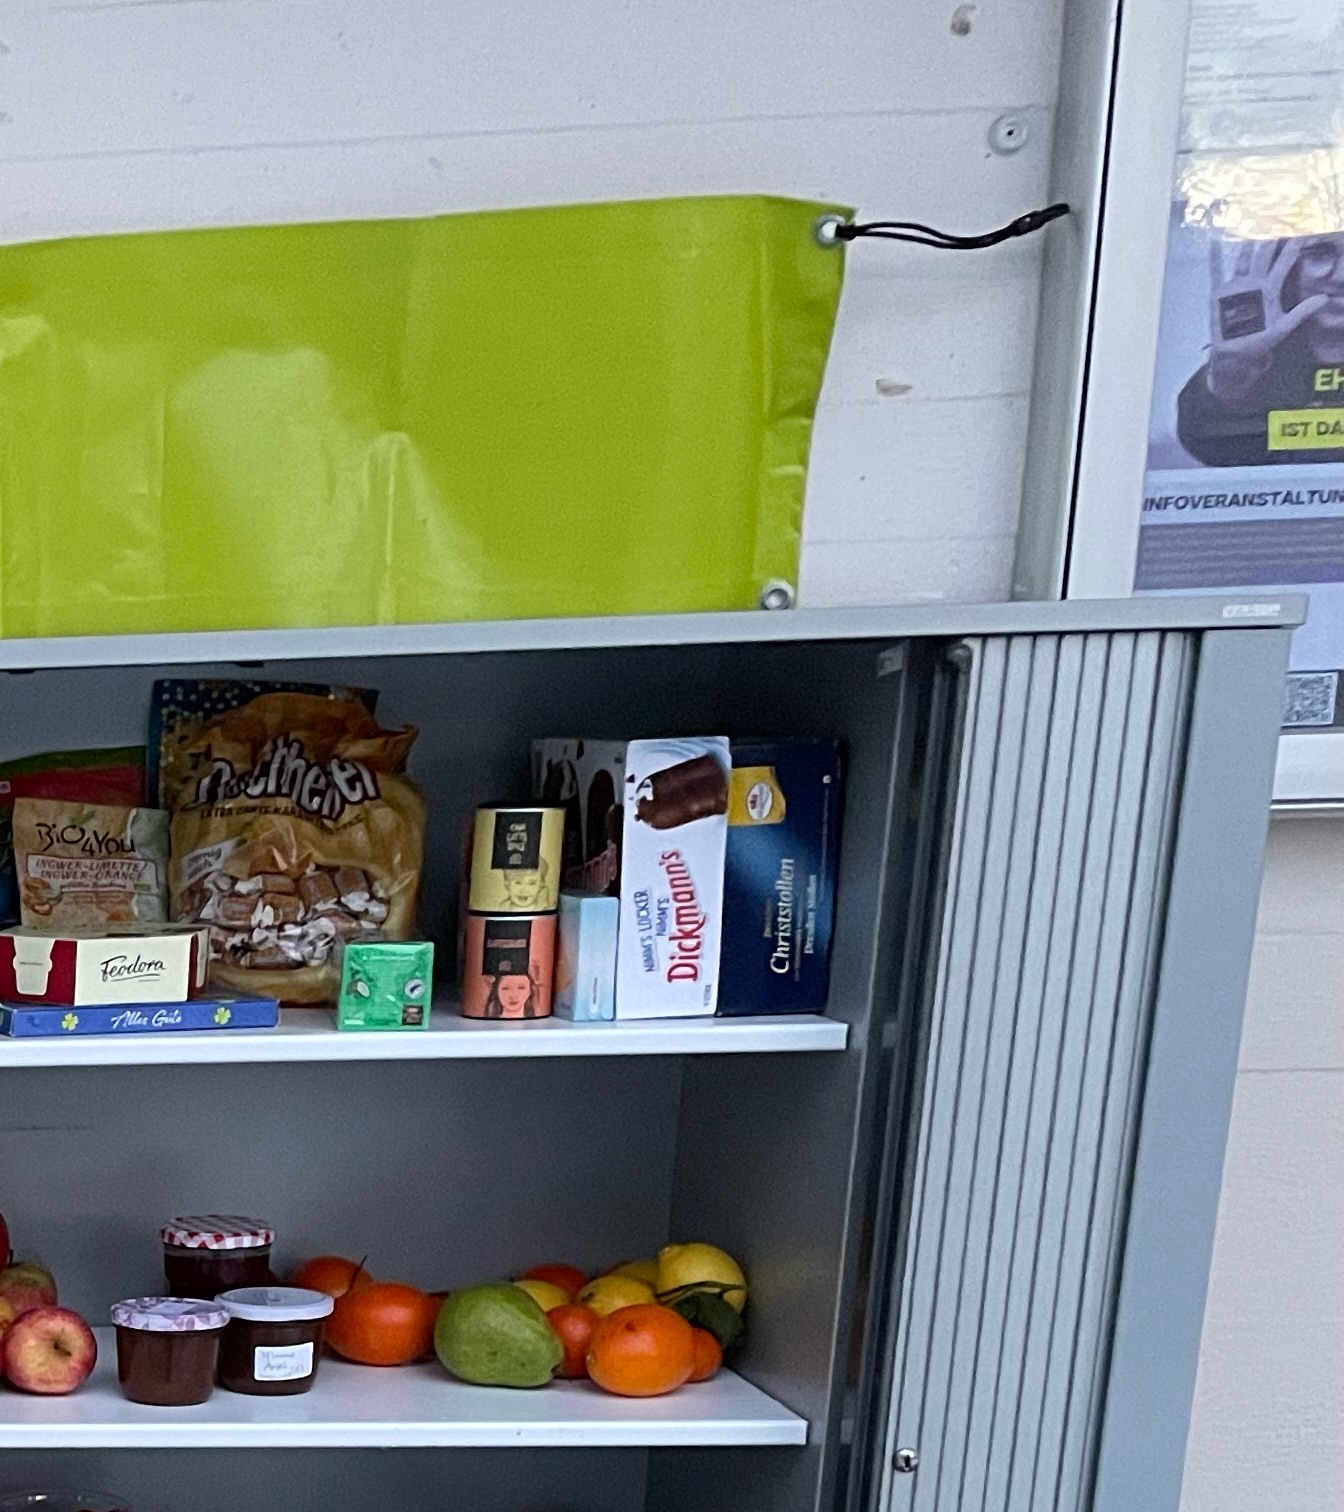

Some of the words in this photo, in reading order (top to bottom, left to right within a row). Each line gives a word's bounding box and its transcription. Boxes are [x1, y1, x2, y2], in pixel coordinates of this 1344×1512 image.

[1281, 421, 1313, 437] IST
[658, 849, 707, 983] Dickmann's
[770, 858, 794, 974] Christstollen
[100, 954, 167, 982] Feodora
